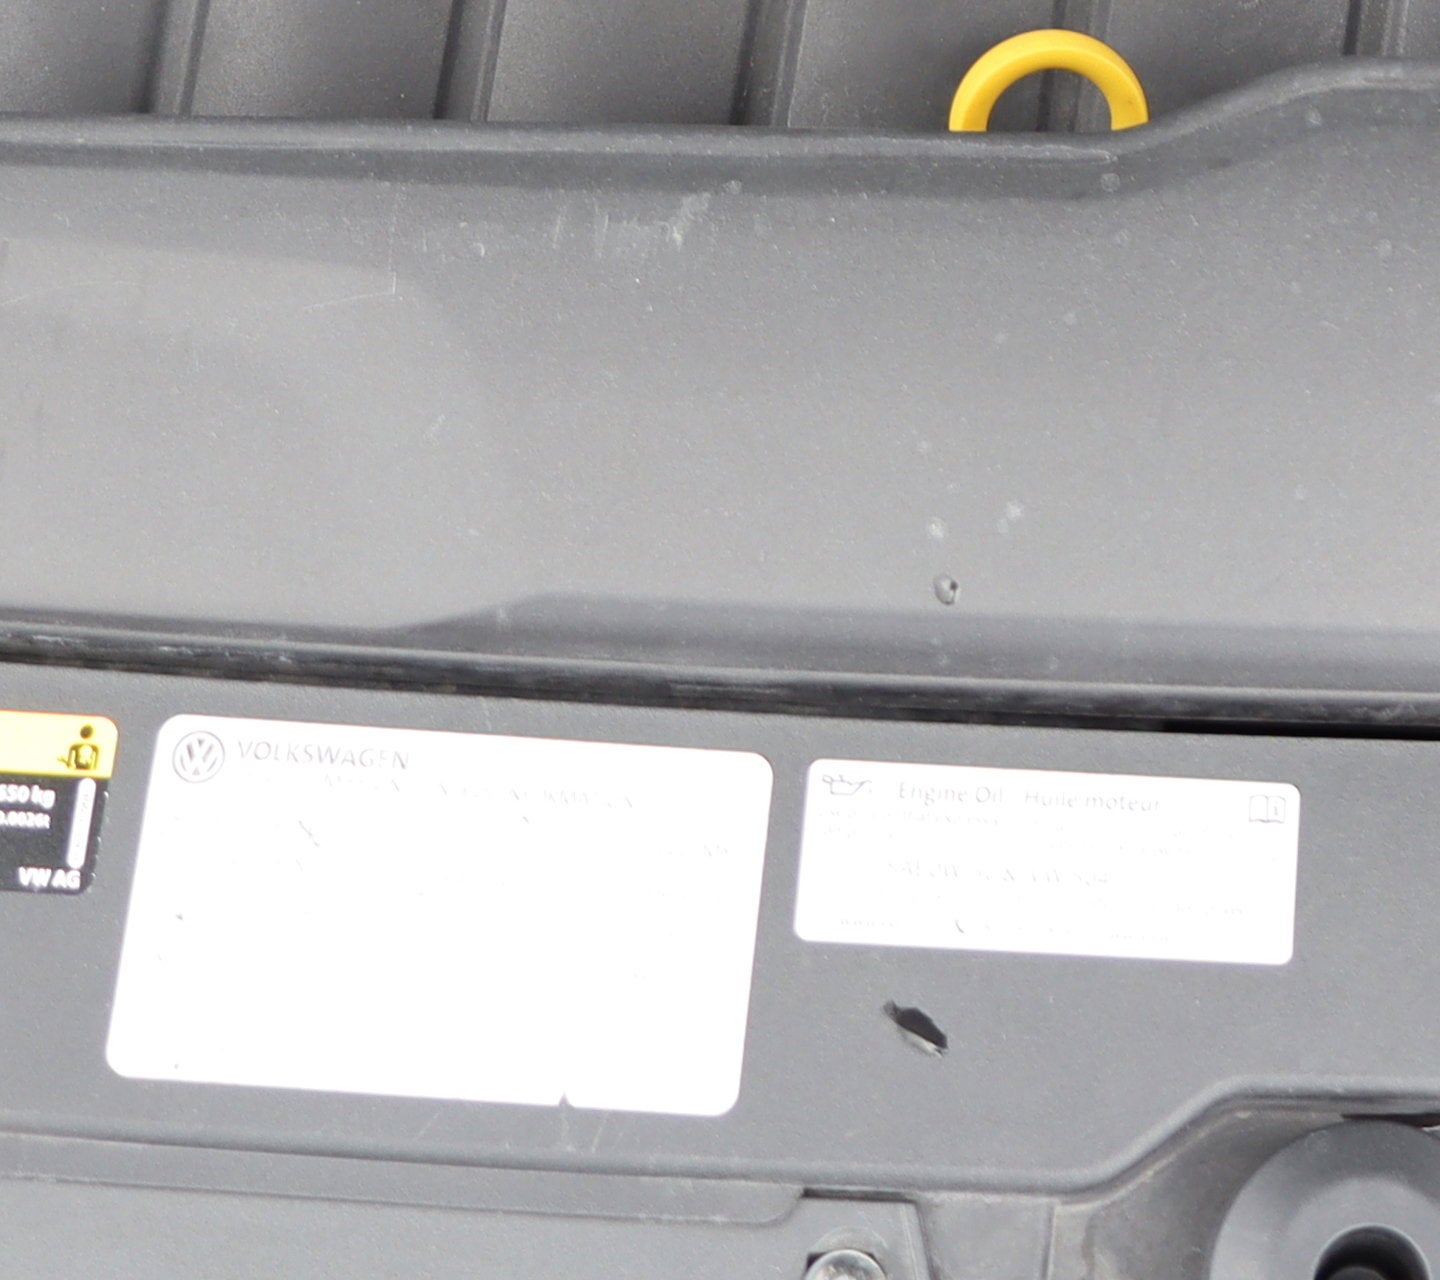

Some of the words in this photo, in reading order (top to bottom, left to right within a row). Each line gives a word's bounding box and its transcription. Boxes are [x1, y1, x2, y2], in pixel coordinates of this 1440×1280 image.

[31, 785, 55, 808] kg
[18, 867, 55, 888] VW
[55, 869, 81, 889] AG
